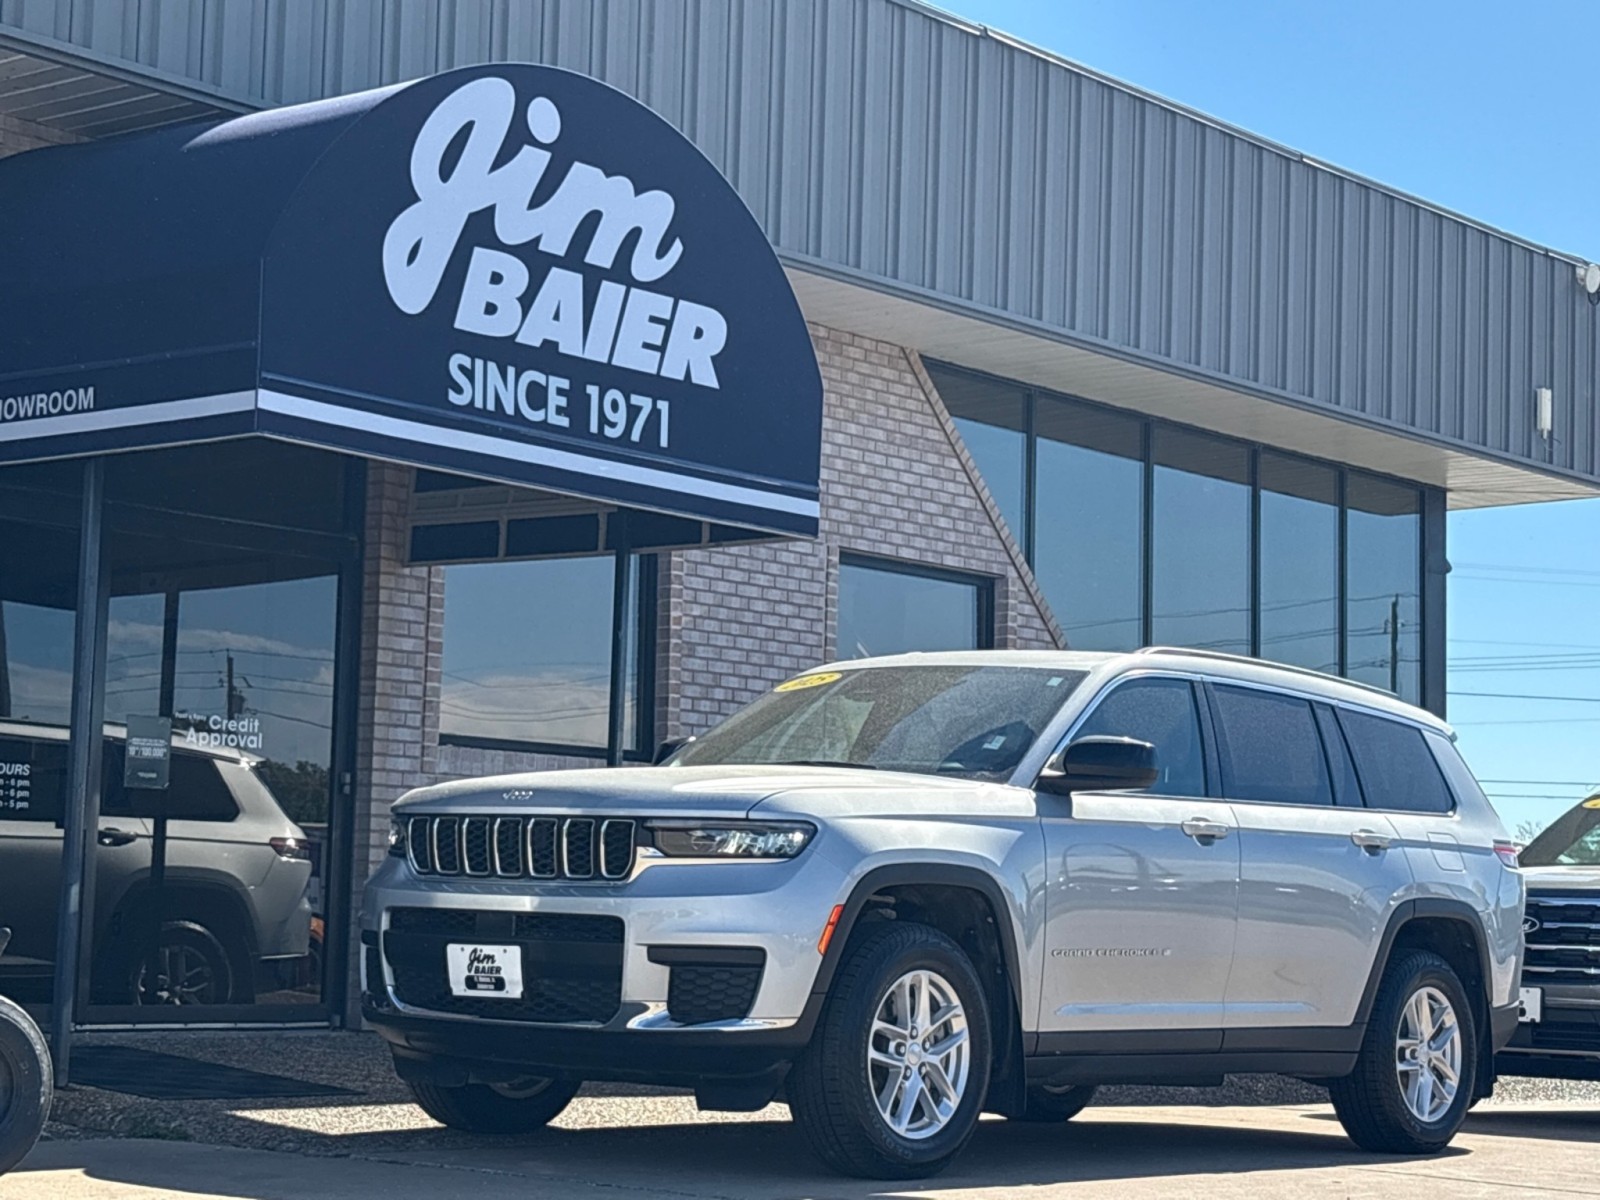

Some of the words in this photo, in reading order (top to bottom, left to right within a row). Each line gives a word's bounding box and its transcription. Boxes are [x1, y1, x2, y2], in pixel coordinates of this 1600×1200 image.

[382, 76, 684, 315] Jim
[453, 246, 728, 389] BAIER
[448, 353, 570, 428] SINCE
[585, 384, 670, 448] 1971
[209, 715, 260, 733] Credit
[186, 727, 263, 749] Approval
[9, 788, 15, 797] 6
[16, 789, 30, 799] pm
[17, 779, 31, 788] pm
[9, 799, 15, 808] 5
[16, 801, 29, 810] pm
[467, 947, 497, 974] Jim
[474, 965, 502, 975] BAIER
